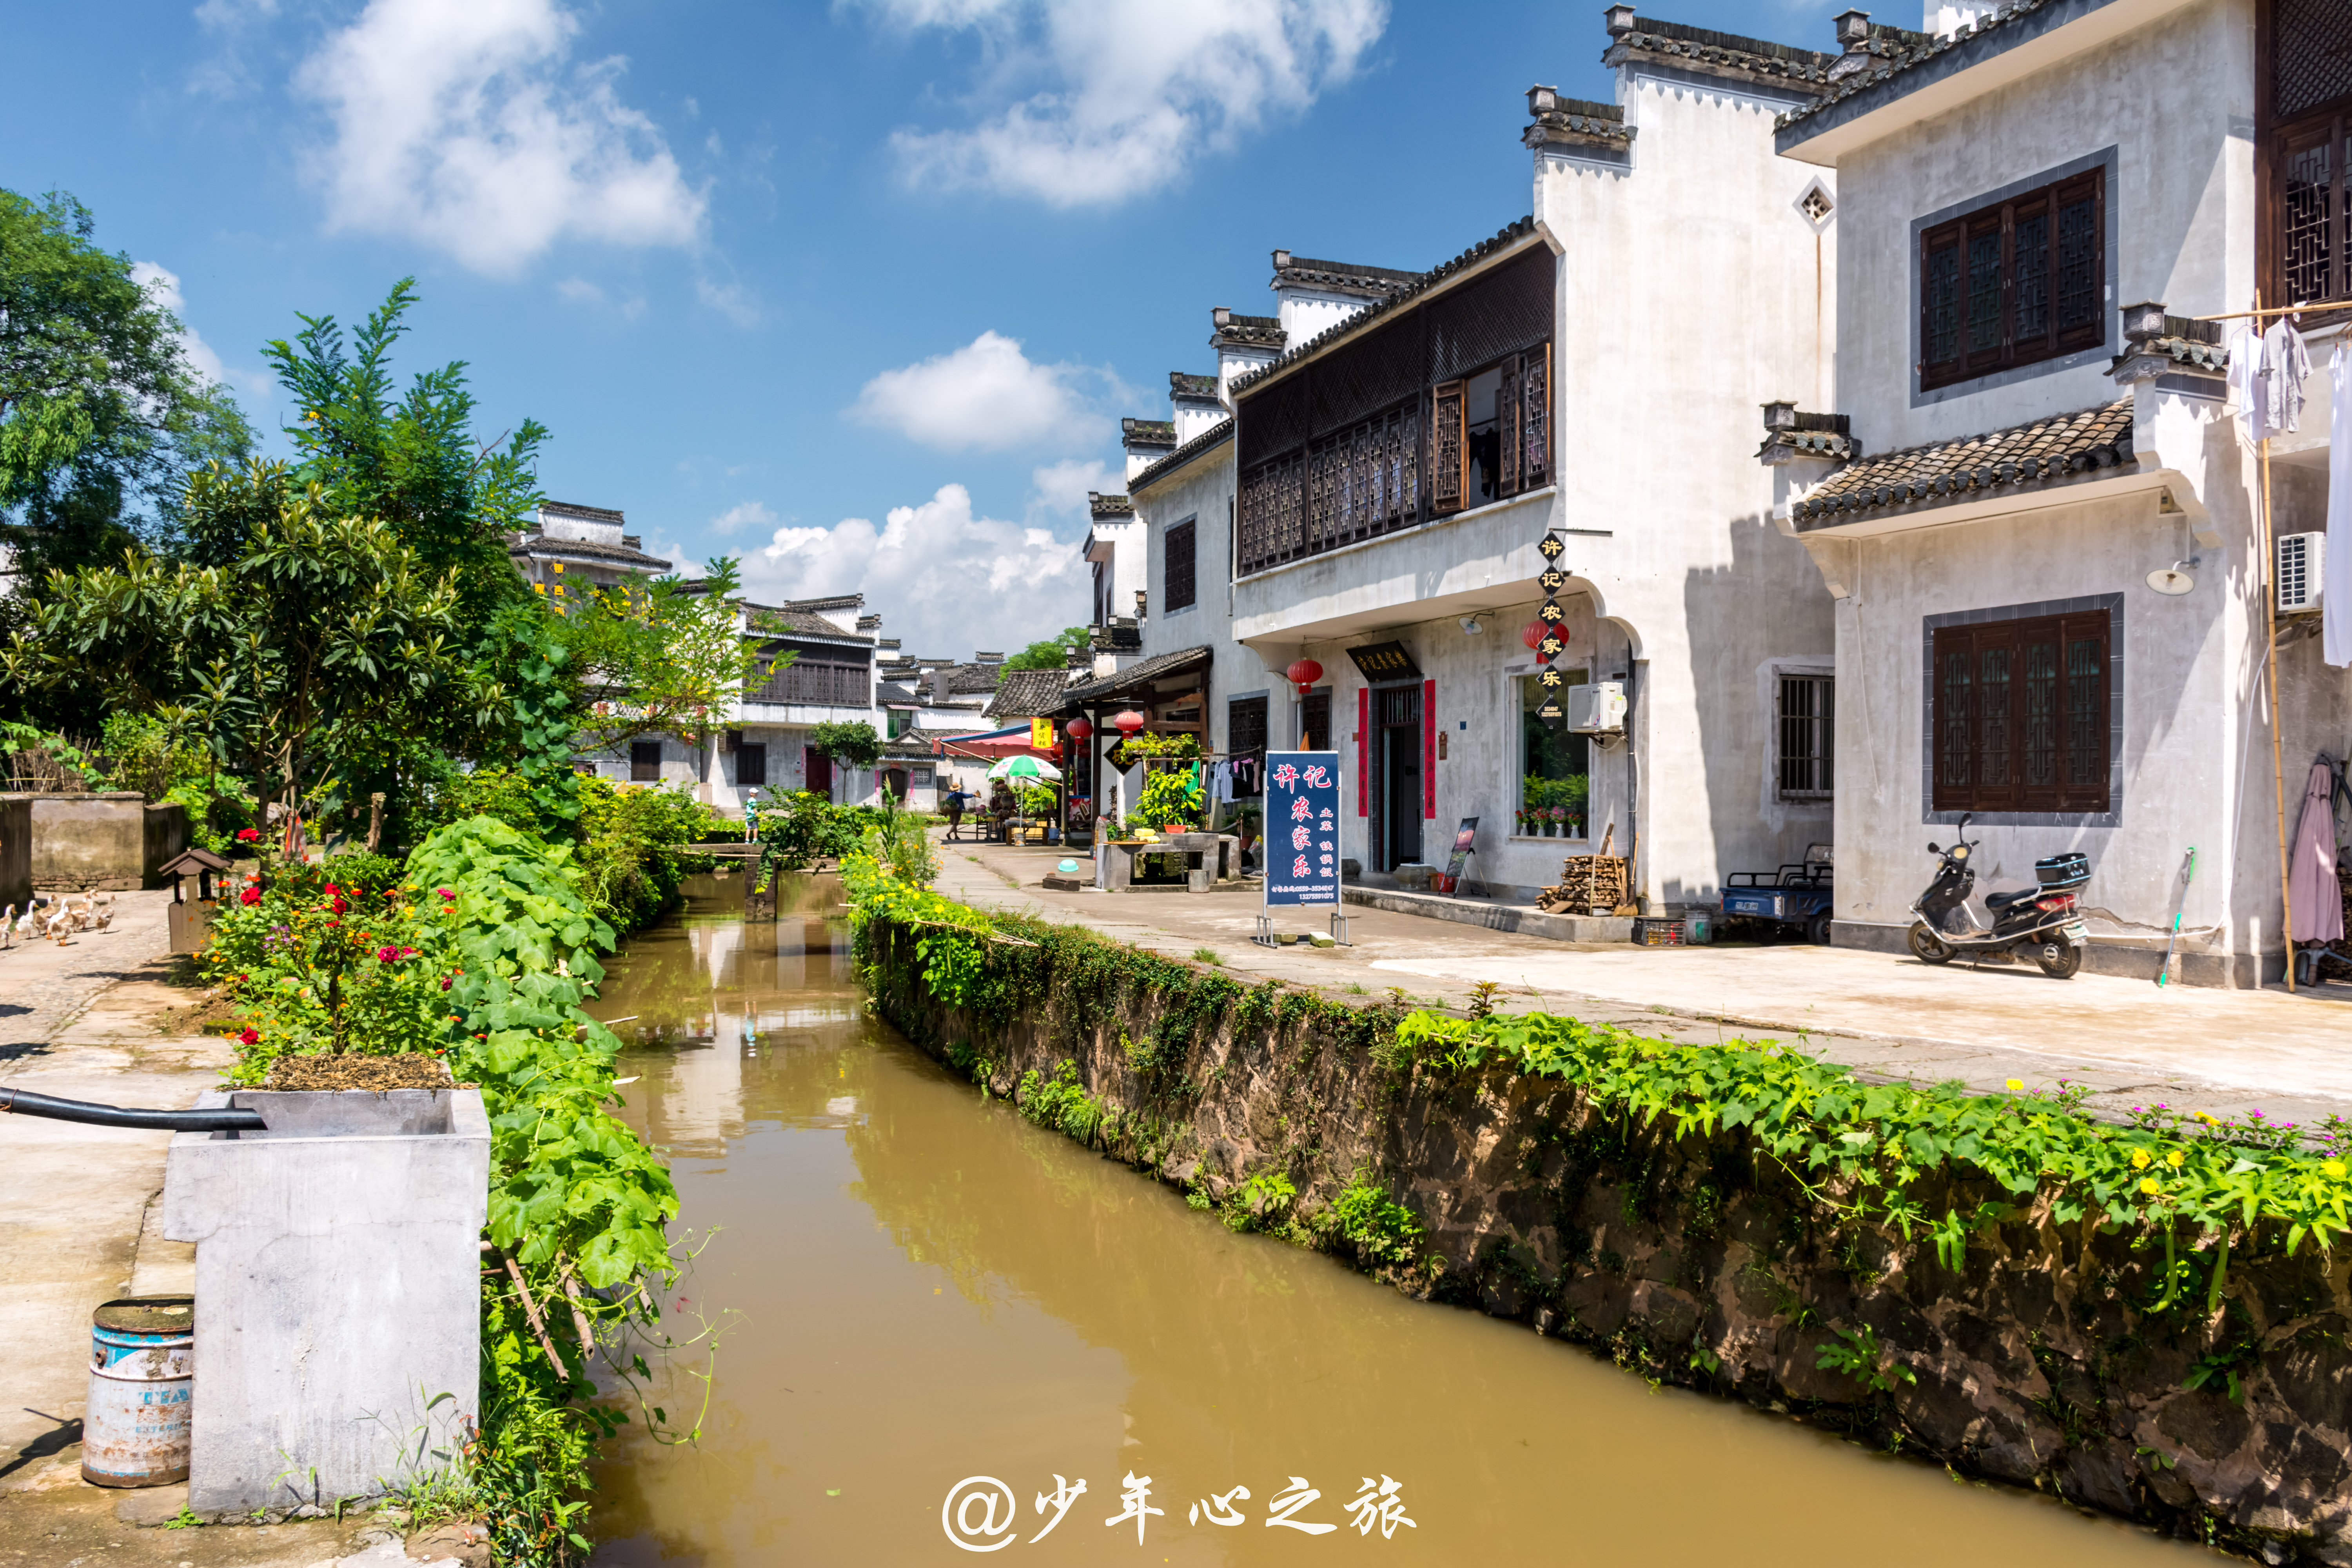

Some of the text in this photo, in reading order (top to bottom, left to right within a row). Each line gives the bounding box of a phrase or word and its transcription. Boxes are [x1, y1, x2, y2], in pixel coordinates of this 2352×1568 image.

[1542, 540, 1562, 686] 许记农家乐
[1273, 764, 1332, 794] 许记
[1291, 796, 1313, 878] 农家乐
[1319, 808, 1334, 878] 土菜 铁锅饭
